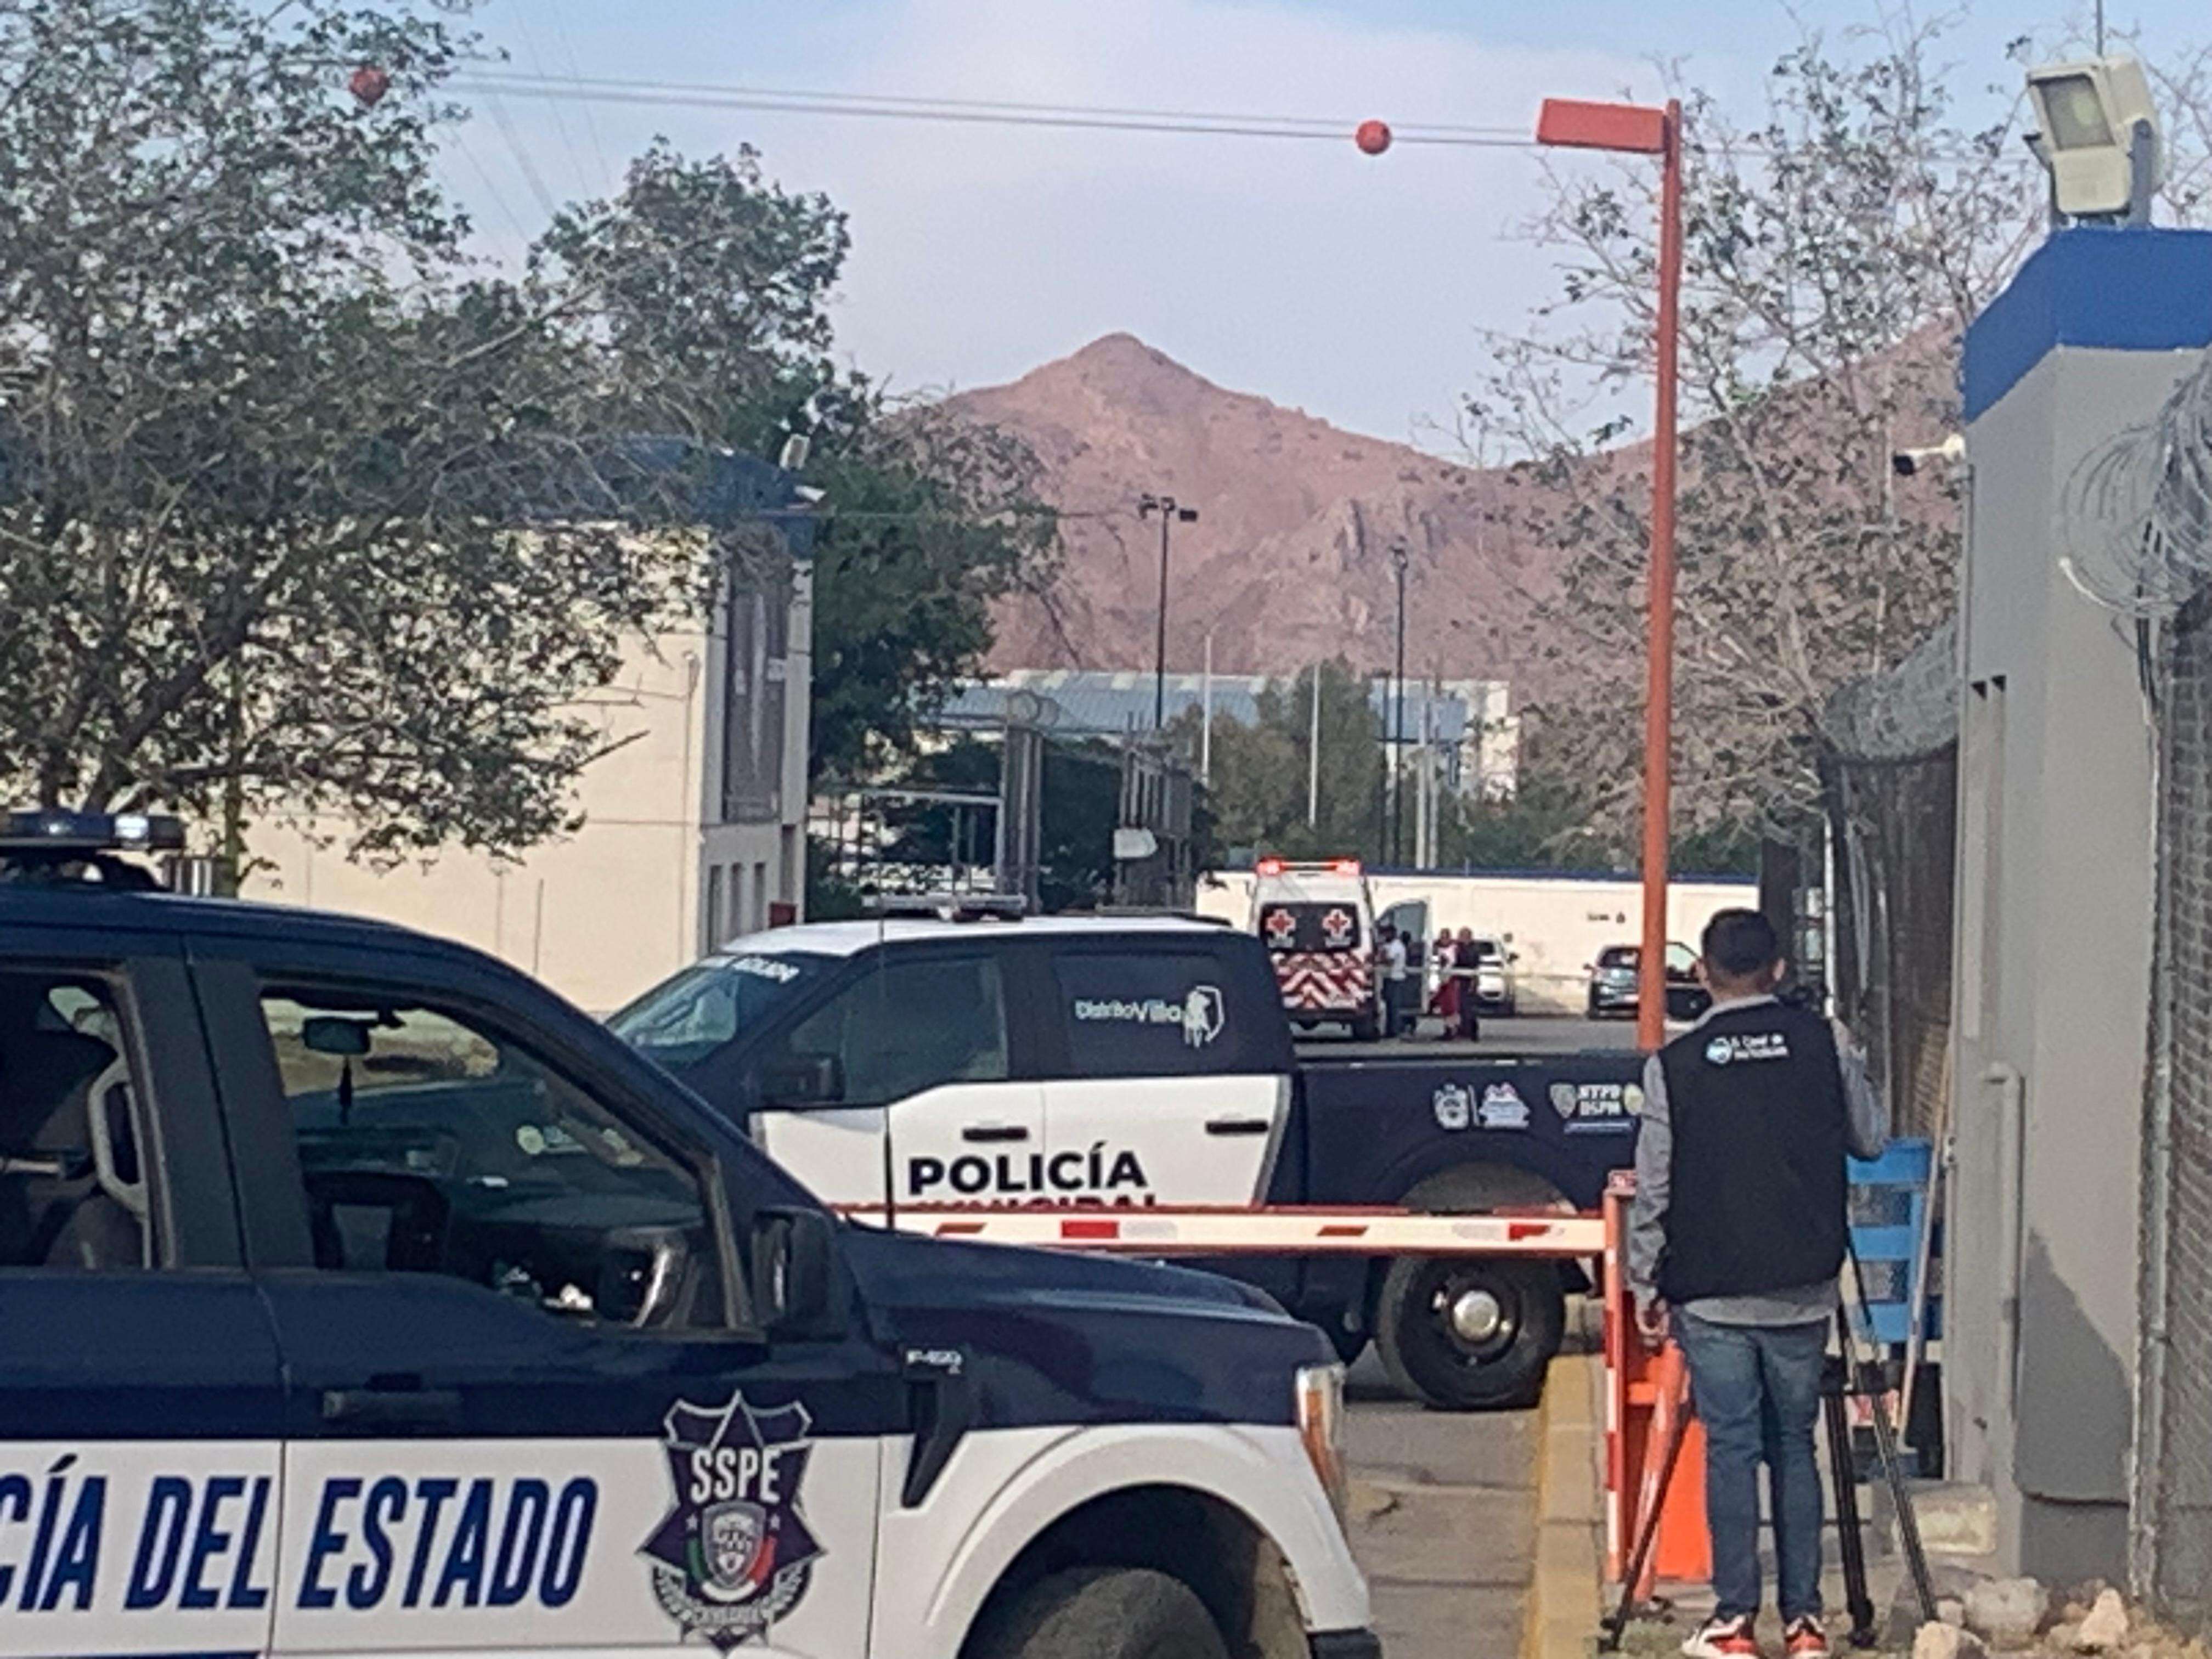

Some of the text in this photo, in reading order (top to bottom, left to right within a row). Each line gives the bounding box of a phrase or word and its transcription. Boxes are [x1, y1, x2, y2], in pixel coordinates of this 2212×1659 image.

[909, 1141, 1149, 1196] POLICÍA
[690, 1446, 782, 1504] SSPE
[122, 1476, 273, 1611] DEL
[296, 1476, 600, 1610] ESTADO
